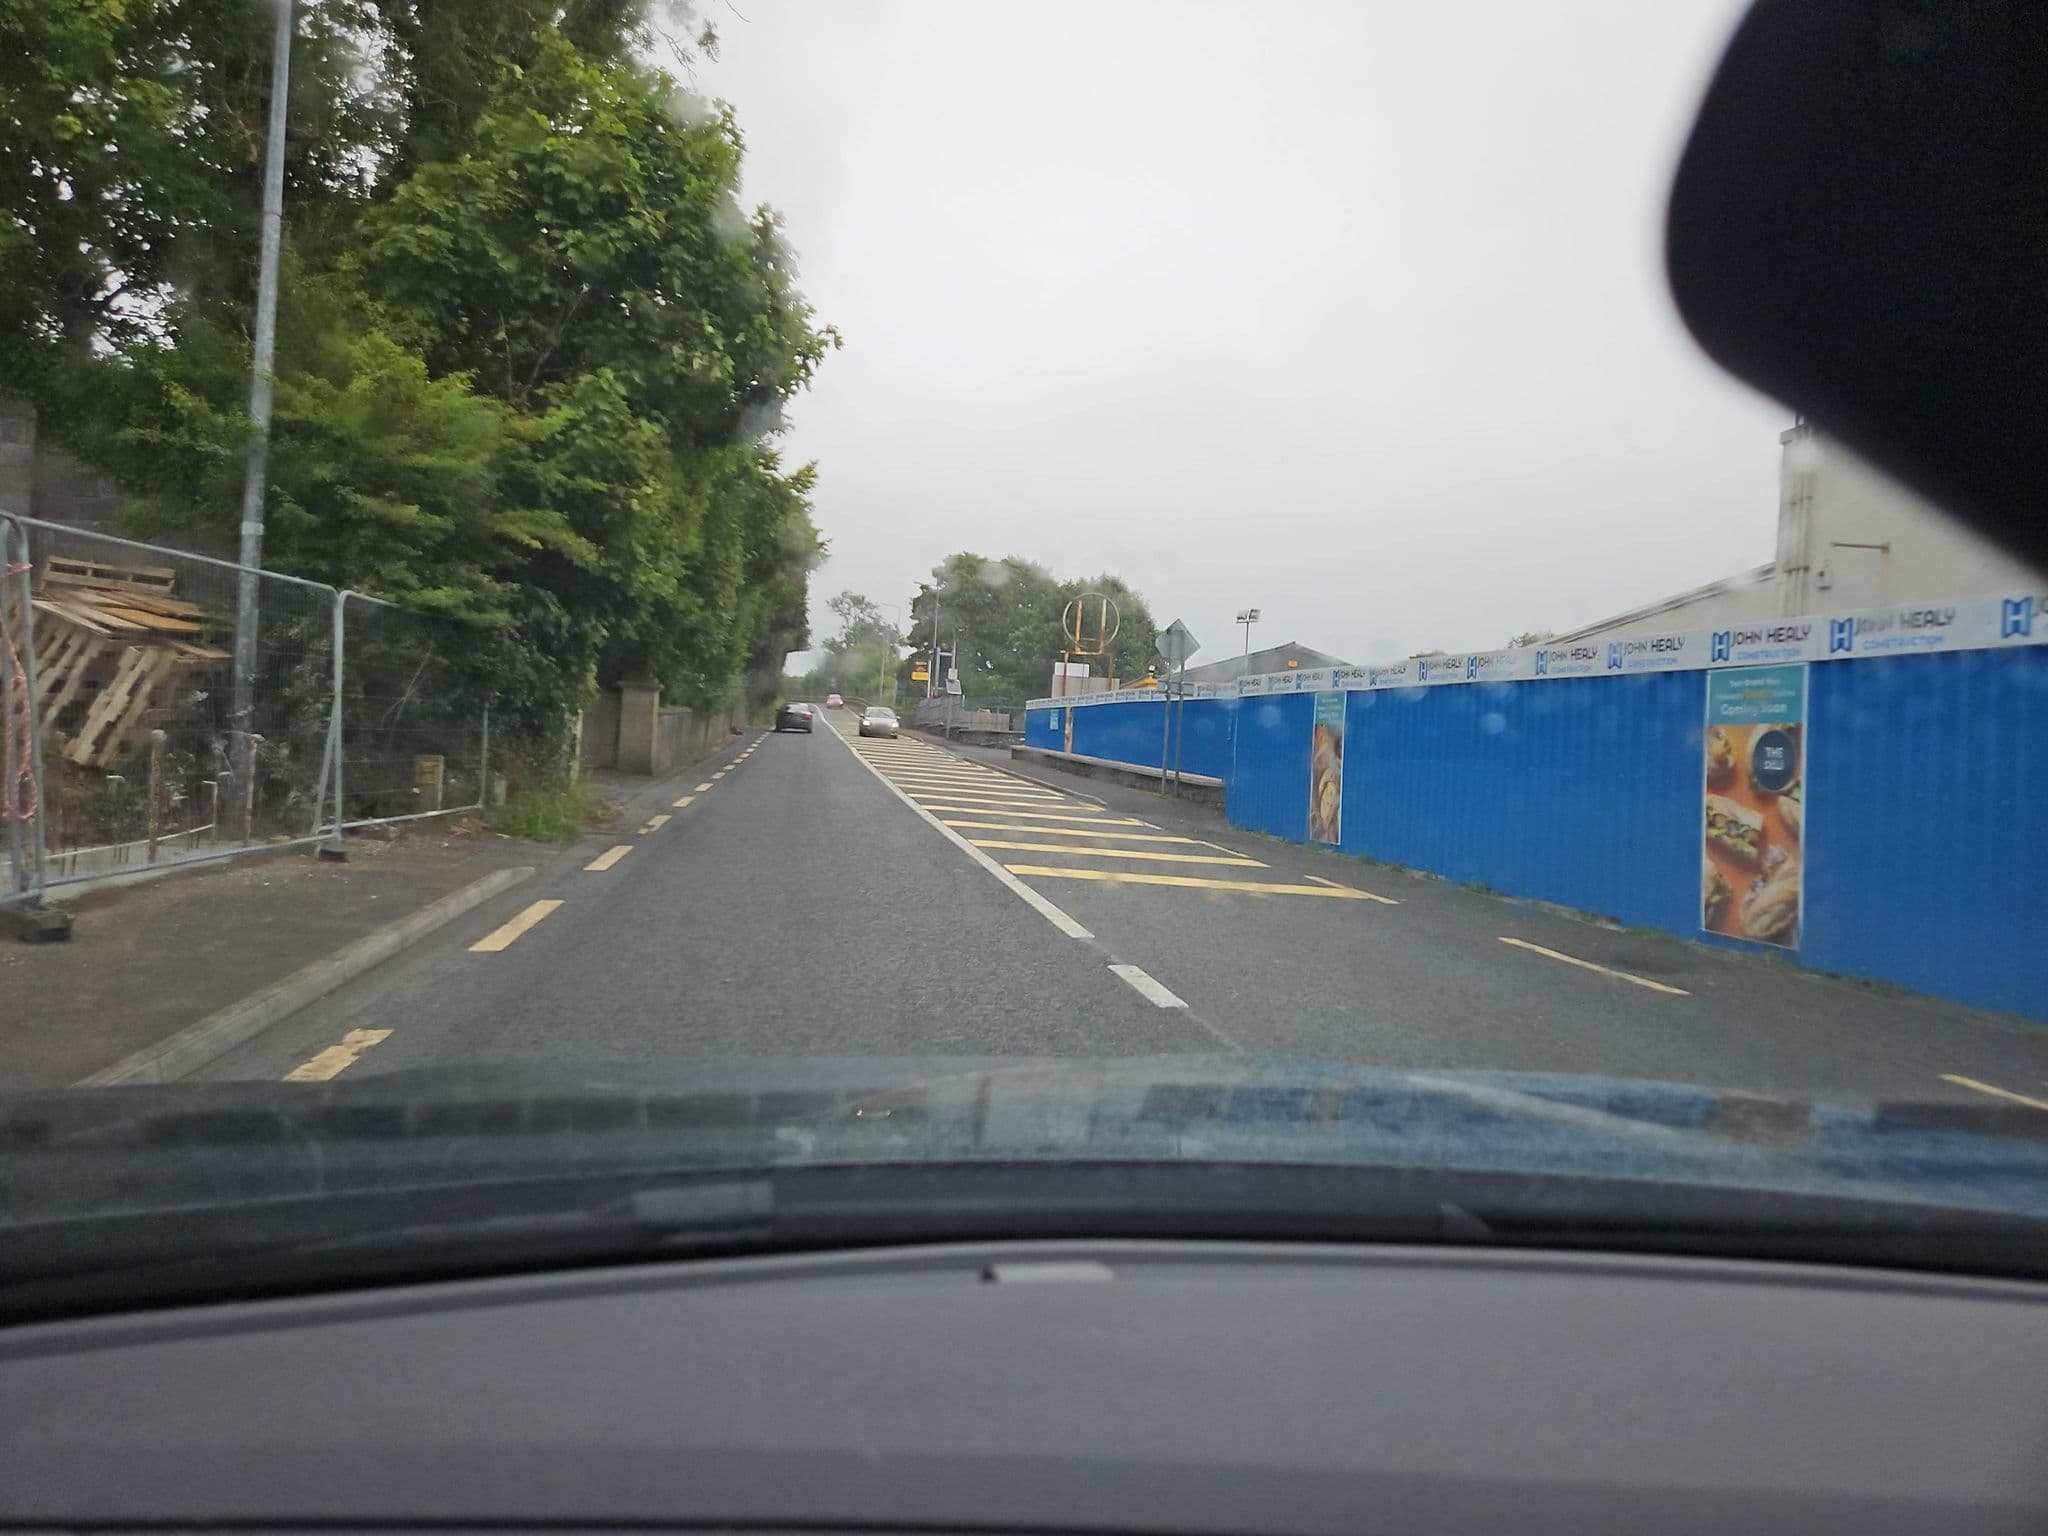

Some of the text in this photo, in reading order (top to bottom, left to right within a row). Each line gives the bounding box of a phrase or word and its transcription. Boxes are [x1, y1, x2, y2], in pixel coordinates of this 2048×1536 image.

[1899, 607, 1957, 632] HEALY
[1624, 636, 1687, 656] JOHN HEALY
[1731, 623, 1812, 648] JOHN HEALY
[1764, 746, 1784, 758] THE
